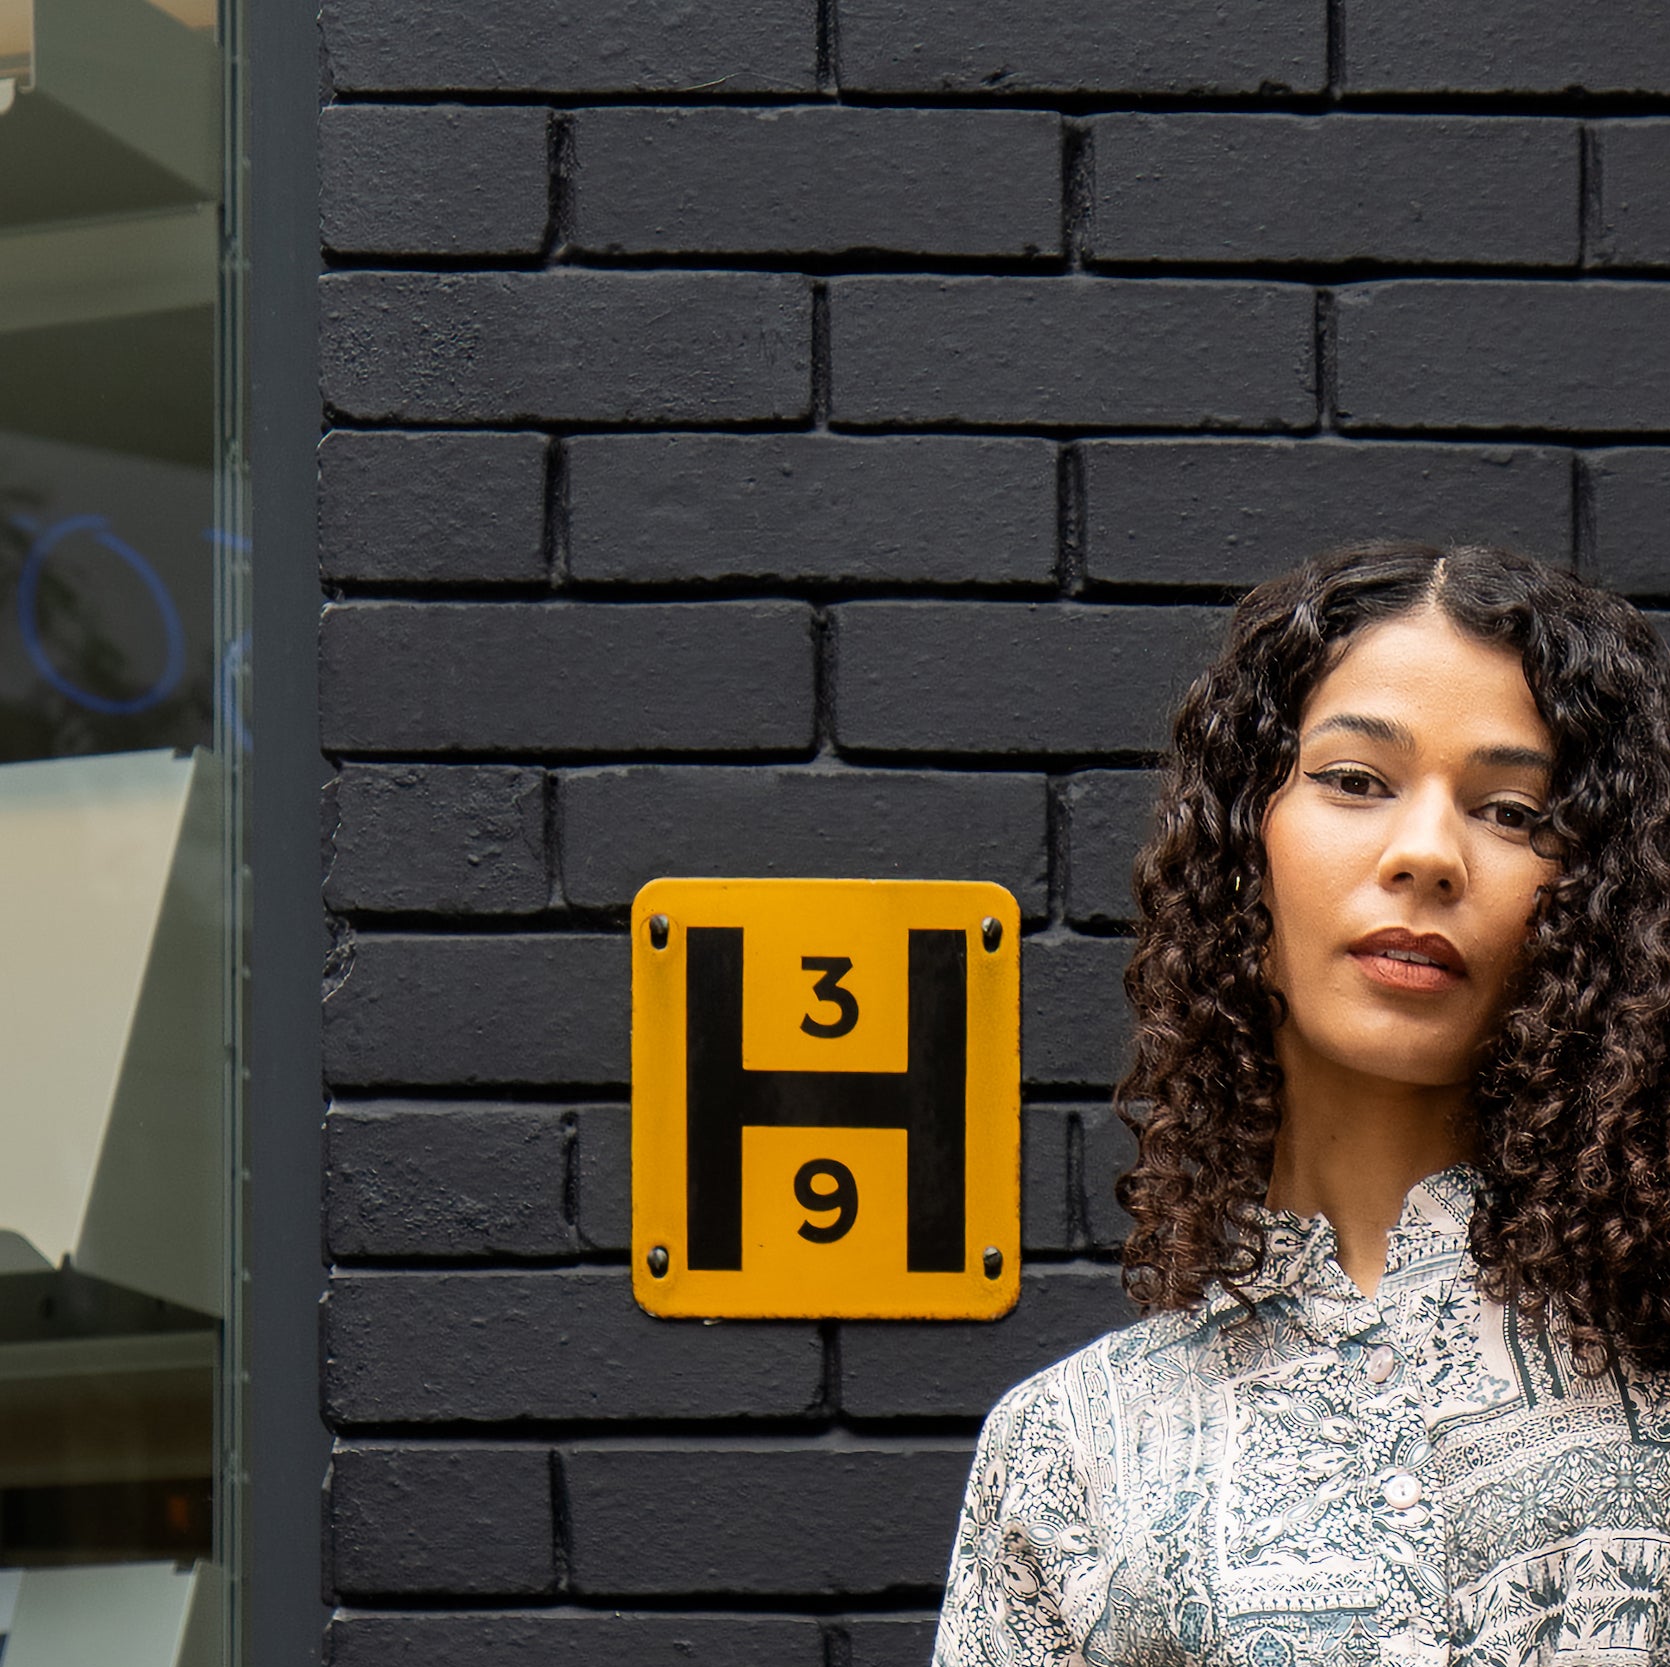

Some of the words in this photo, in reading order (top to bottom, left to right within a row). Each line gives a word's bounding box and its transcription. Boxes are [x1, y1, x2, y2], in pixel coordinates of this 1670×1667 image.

[800, 956, 859, 1039] 3
[686, 927, 967, 1273] H
[793, 1158, 859, 1244] 9
